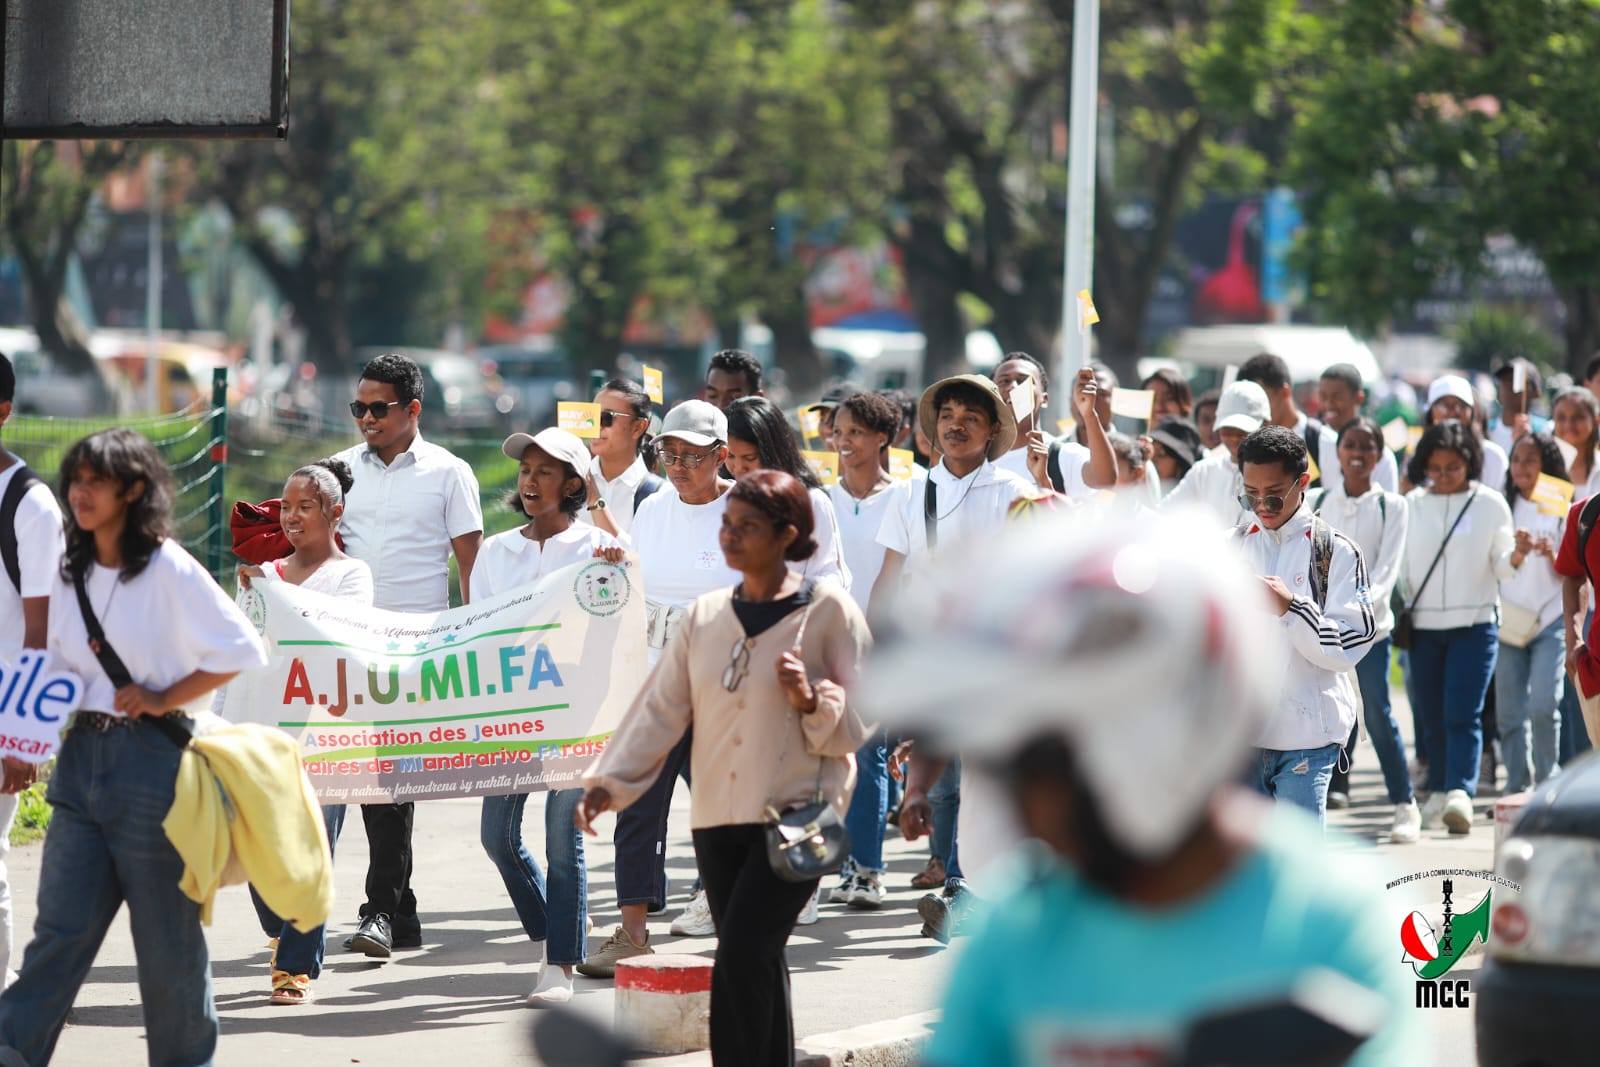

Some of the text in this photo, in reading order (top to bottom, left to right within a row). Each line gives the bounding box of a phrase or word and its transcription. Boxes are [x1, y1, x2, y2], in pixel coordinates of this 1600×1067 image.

[0, 655, 76, 723] ile
[283, 643, 563, 717] A.J.U.MI.FA
[305, 719, 544, 747] Association des Jeunes
[367, 757, 393, 774] de
[400, 746, 532, 774] MIandrarivo
[393, 780, 458, 799] fahendrena
[459, 780, 473, 793] sy
[475, 773, 512, 789] nahita
